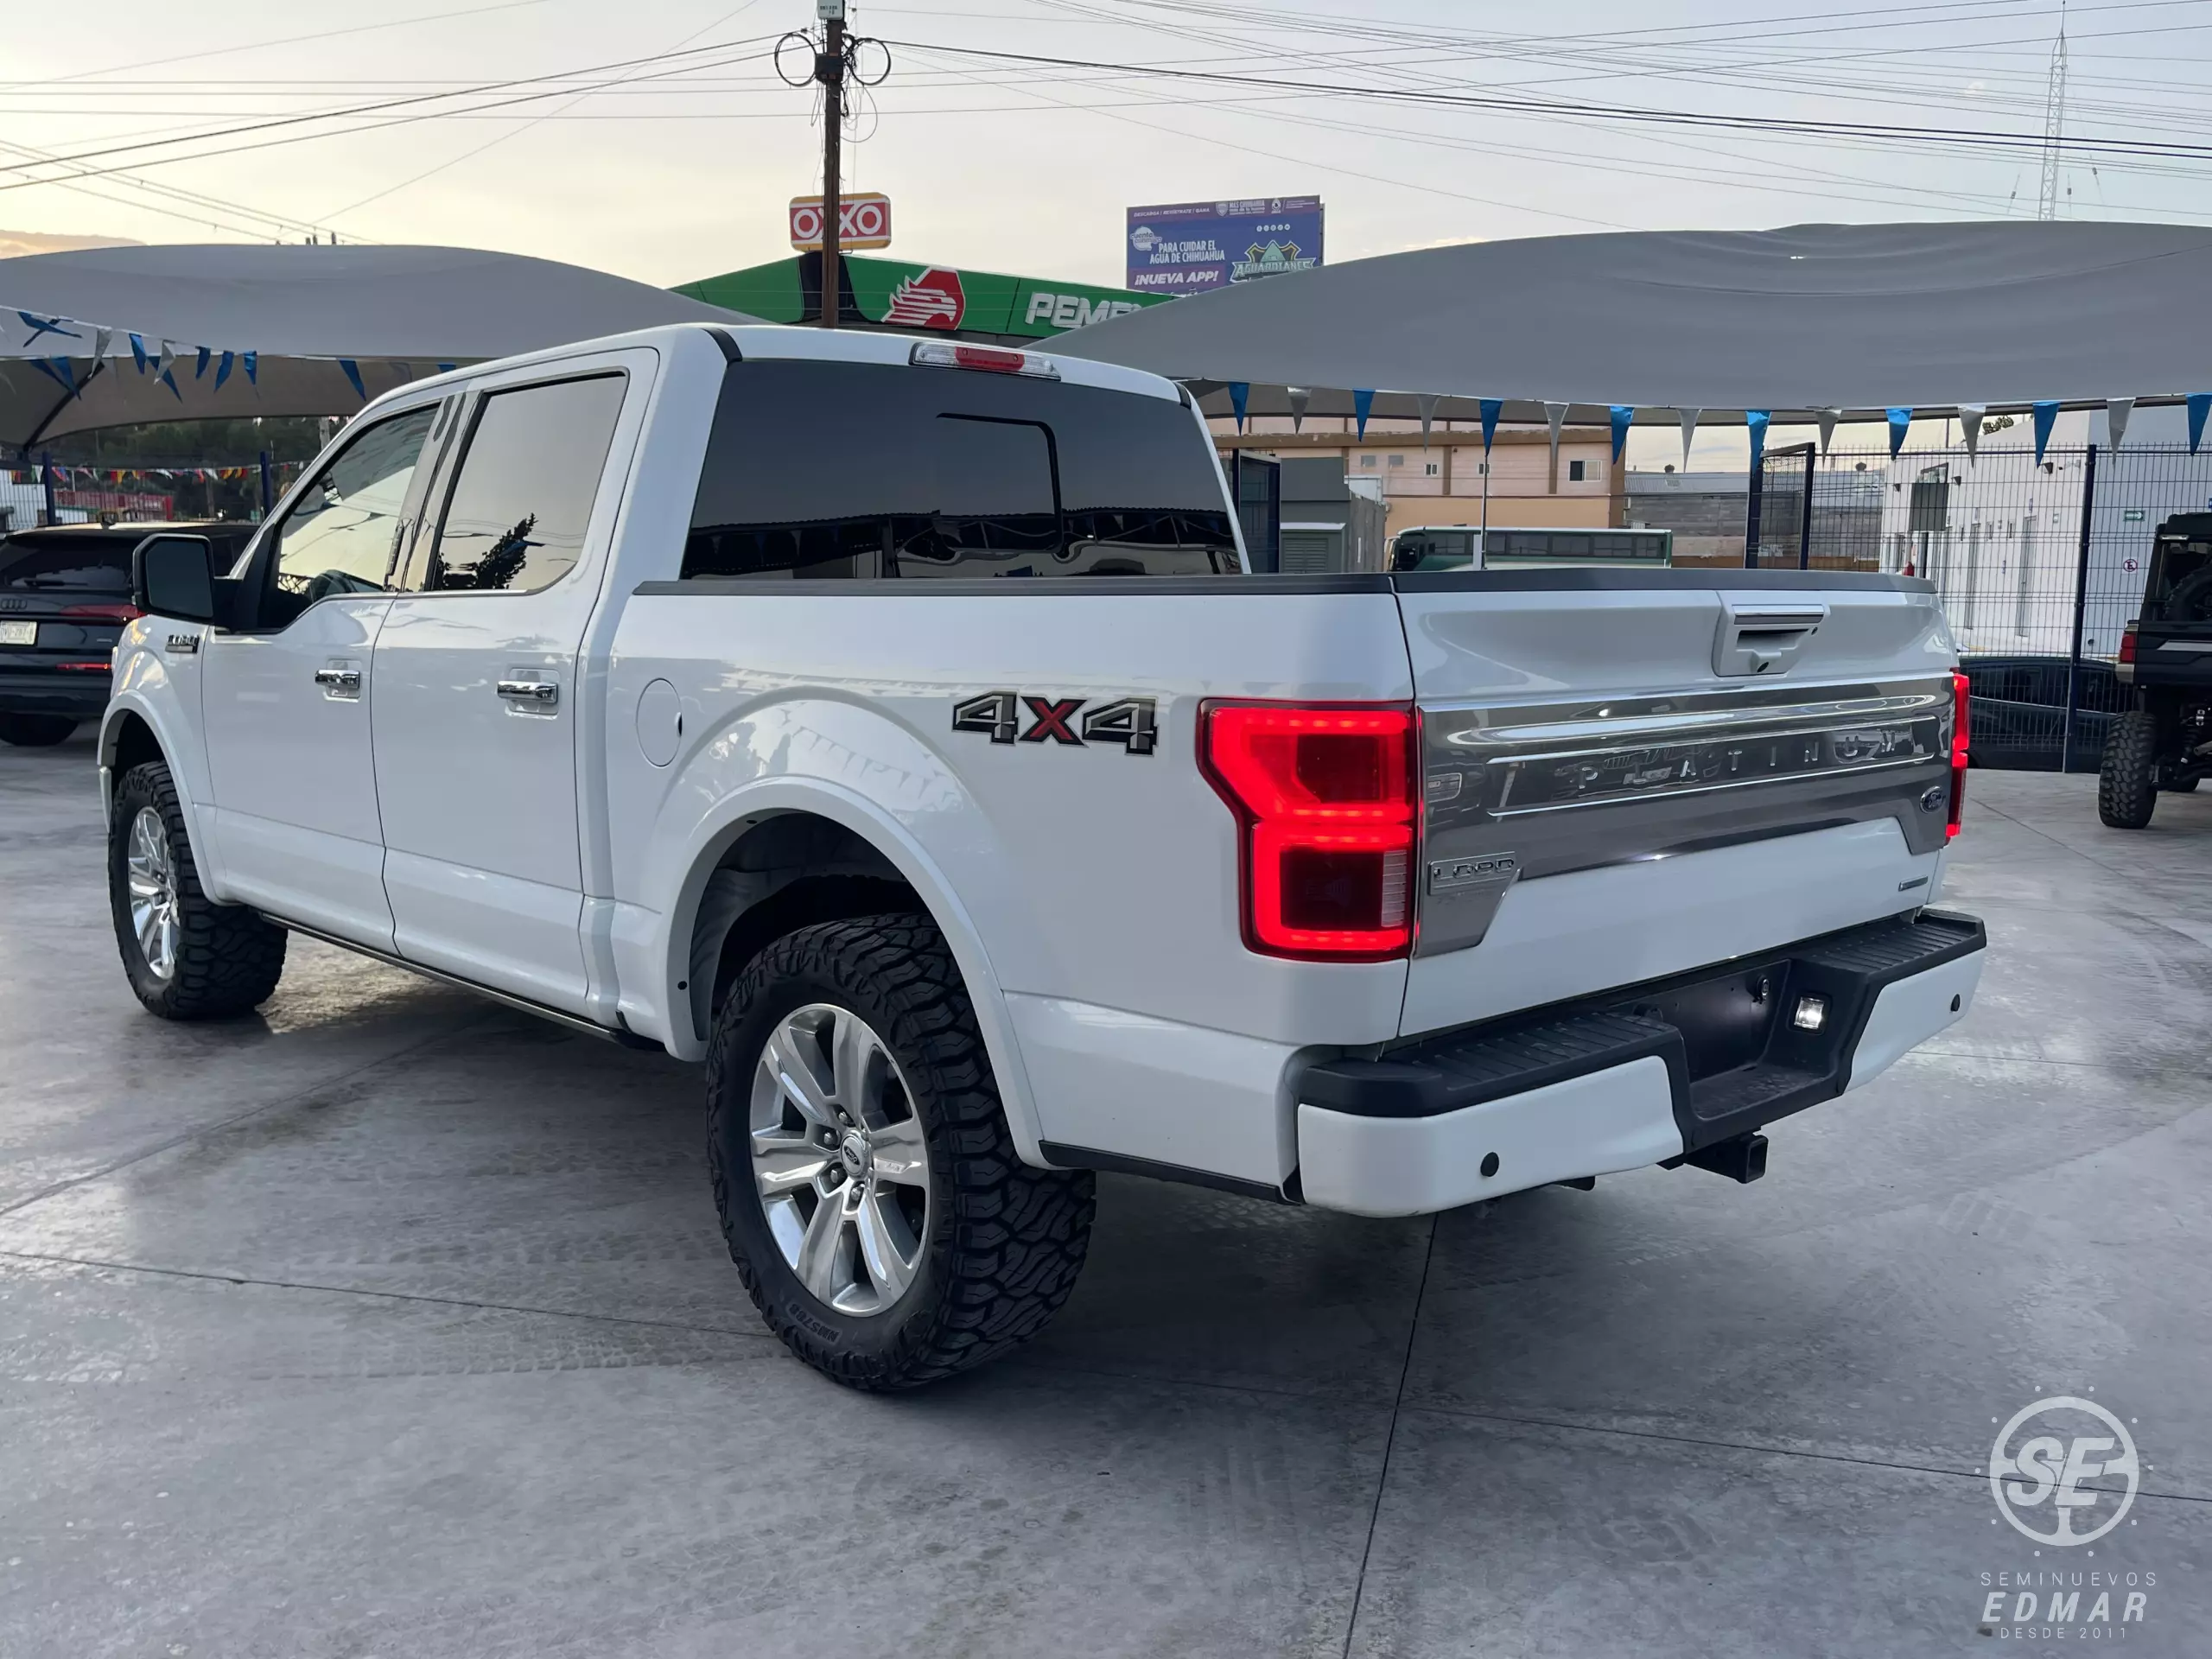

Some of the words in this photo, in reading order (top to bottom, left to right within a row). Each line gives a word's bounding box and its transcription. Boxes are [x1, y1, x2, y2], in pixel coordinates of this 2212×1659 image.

[793, 203, 882, 238] OXO
[1150, 253, 1169, 264] AGUA
[1172, 252, 1181, 263] DE
[1183, 250, 1225, 262] CHIHUAHUA
[1159, 243, 1178, 253] PARA
[1179, 241, 1206, 252] CUIDAR
[1208, 240, 1216, 251] EL
[1135, 272, 1184, 285] ¡NUEVA
[1185, 270, 1219, 283] APP!
[1025, 292, 1141, 328] PEM
[951, 690, 1159, 756] 4X4
[1578, 730, 1897, 790] PLATINUM
